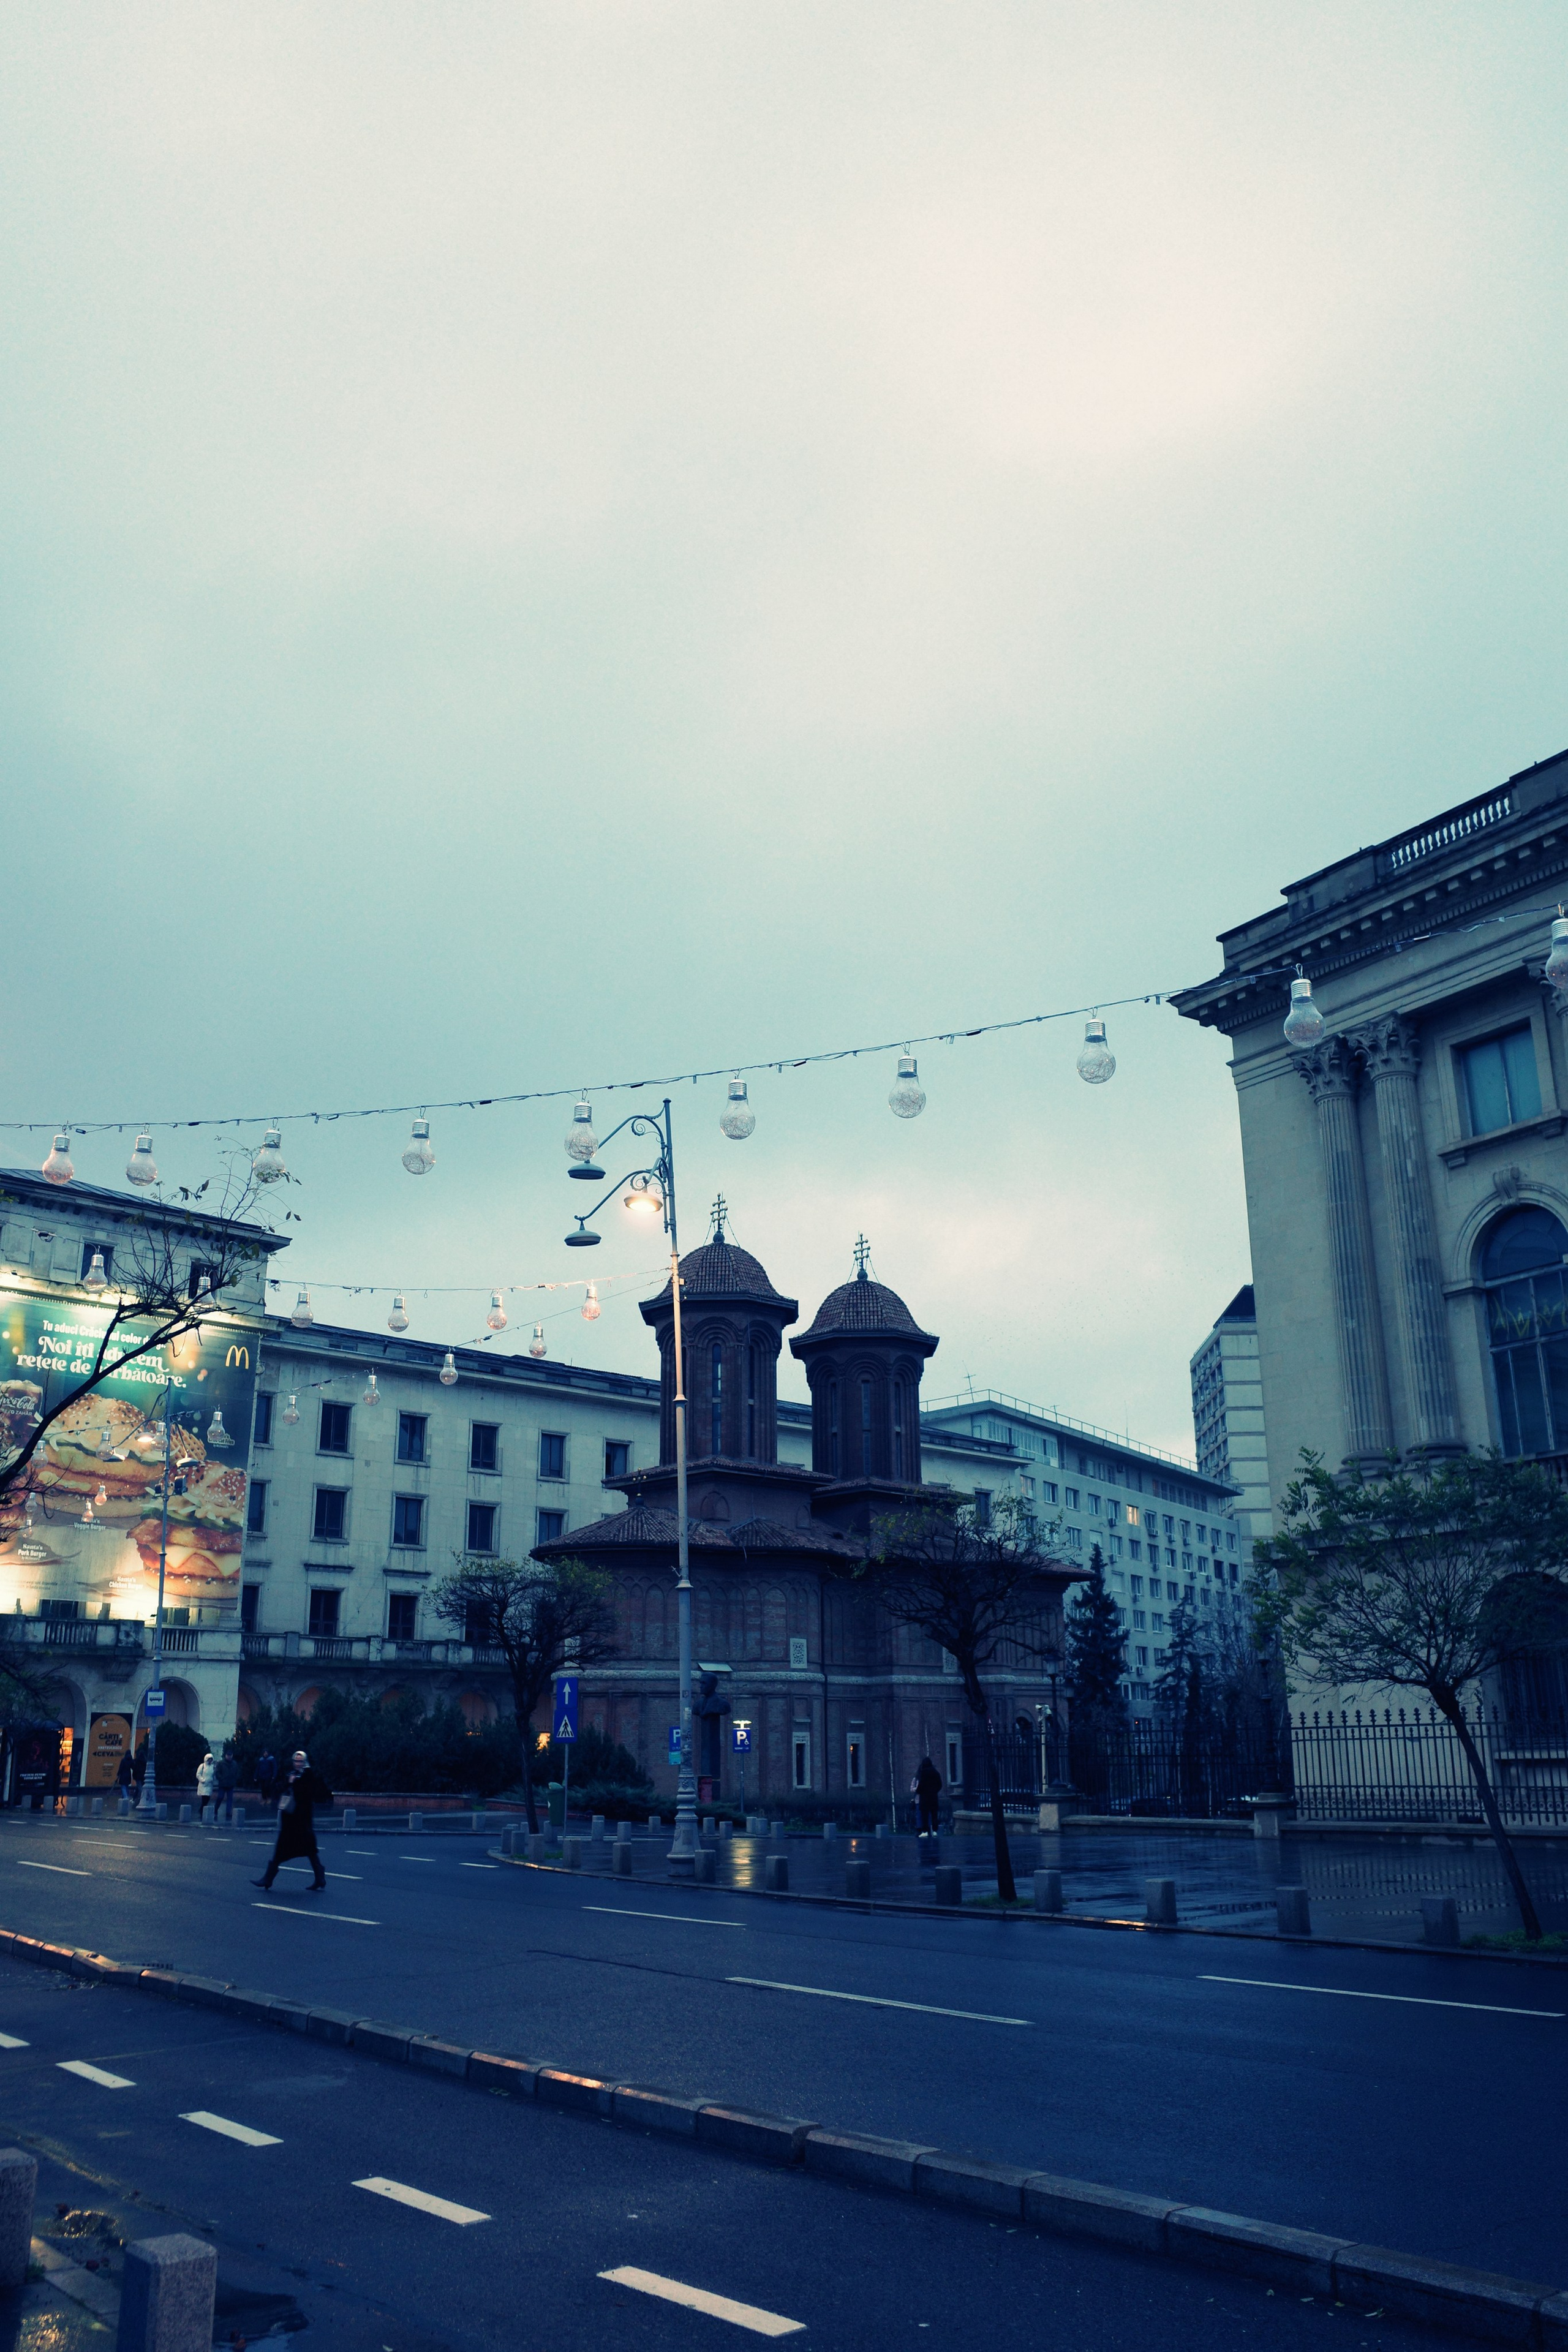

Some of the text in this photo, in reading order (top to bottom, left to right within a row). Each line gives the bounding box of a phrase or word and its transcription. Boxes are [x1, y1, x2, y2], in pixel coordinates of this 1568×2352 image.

[43, 1320, 53, 1331] Tu
[54, 1322, 78, 1335] aduci
[120, 1333, 141, 1344] celor
[38, 1336, 72, 1355] Noi
[17, 1354, 67, 1371] rețete
[70, 1359, 91, 1374] de
[30, 1550, 47, 1558] Burger
[737, 1731, 747, 1745] P
